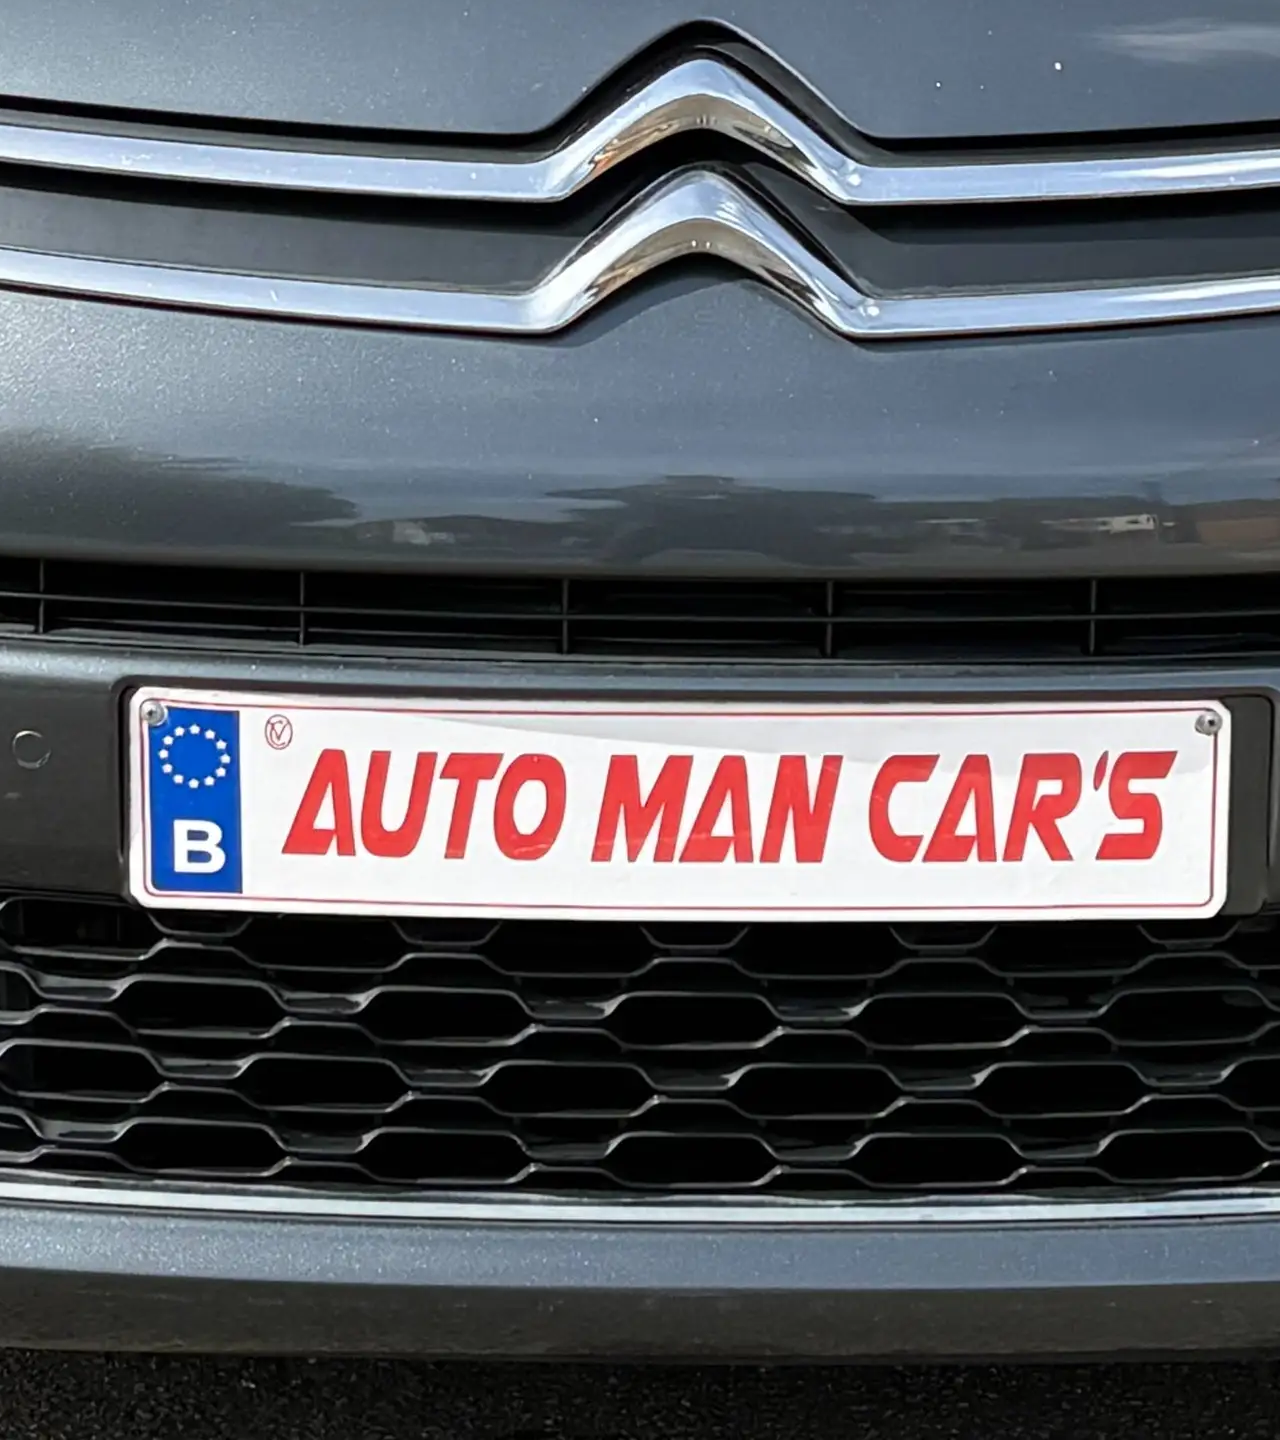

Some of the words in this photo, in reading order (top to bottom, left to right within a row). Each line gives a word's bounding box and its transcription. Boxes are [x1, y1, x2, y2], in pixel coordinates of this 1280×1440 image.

[173, 820, 226, 874] B
[281, 749, 566, 860] AUTO
[592, 755, 842, 863] MAN
[869, 750, 1179, 862] CAR'S
